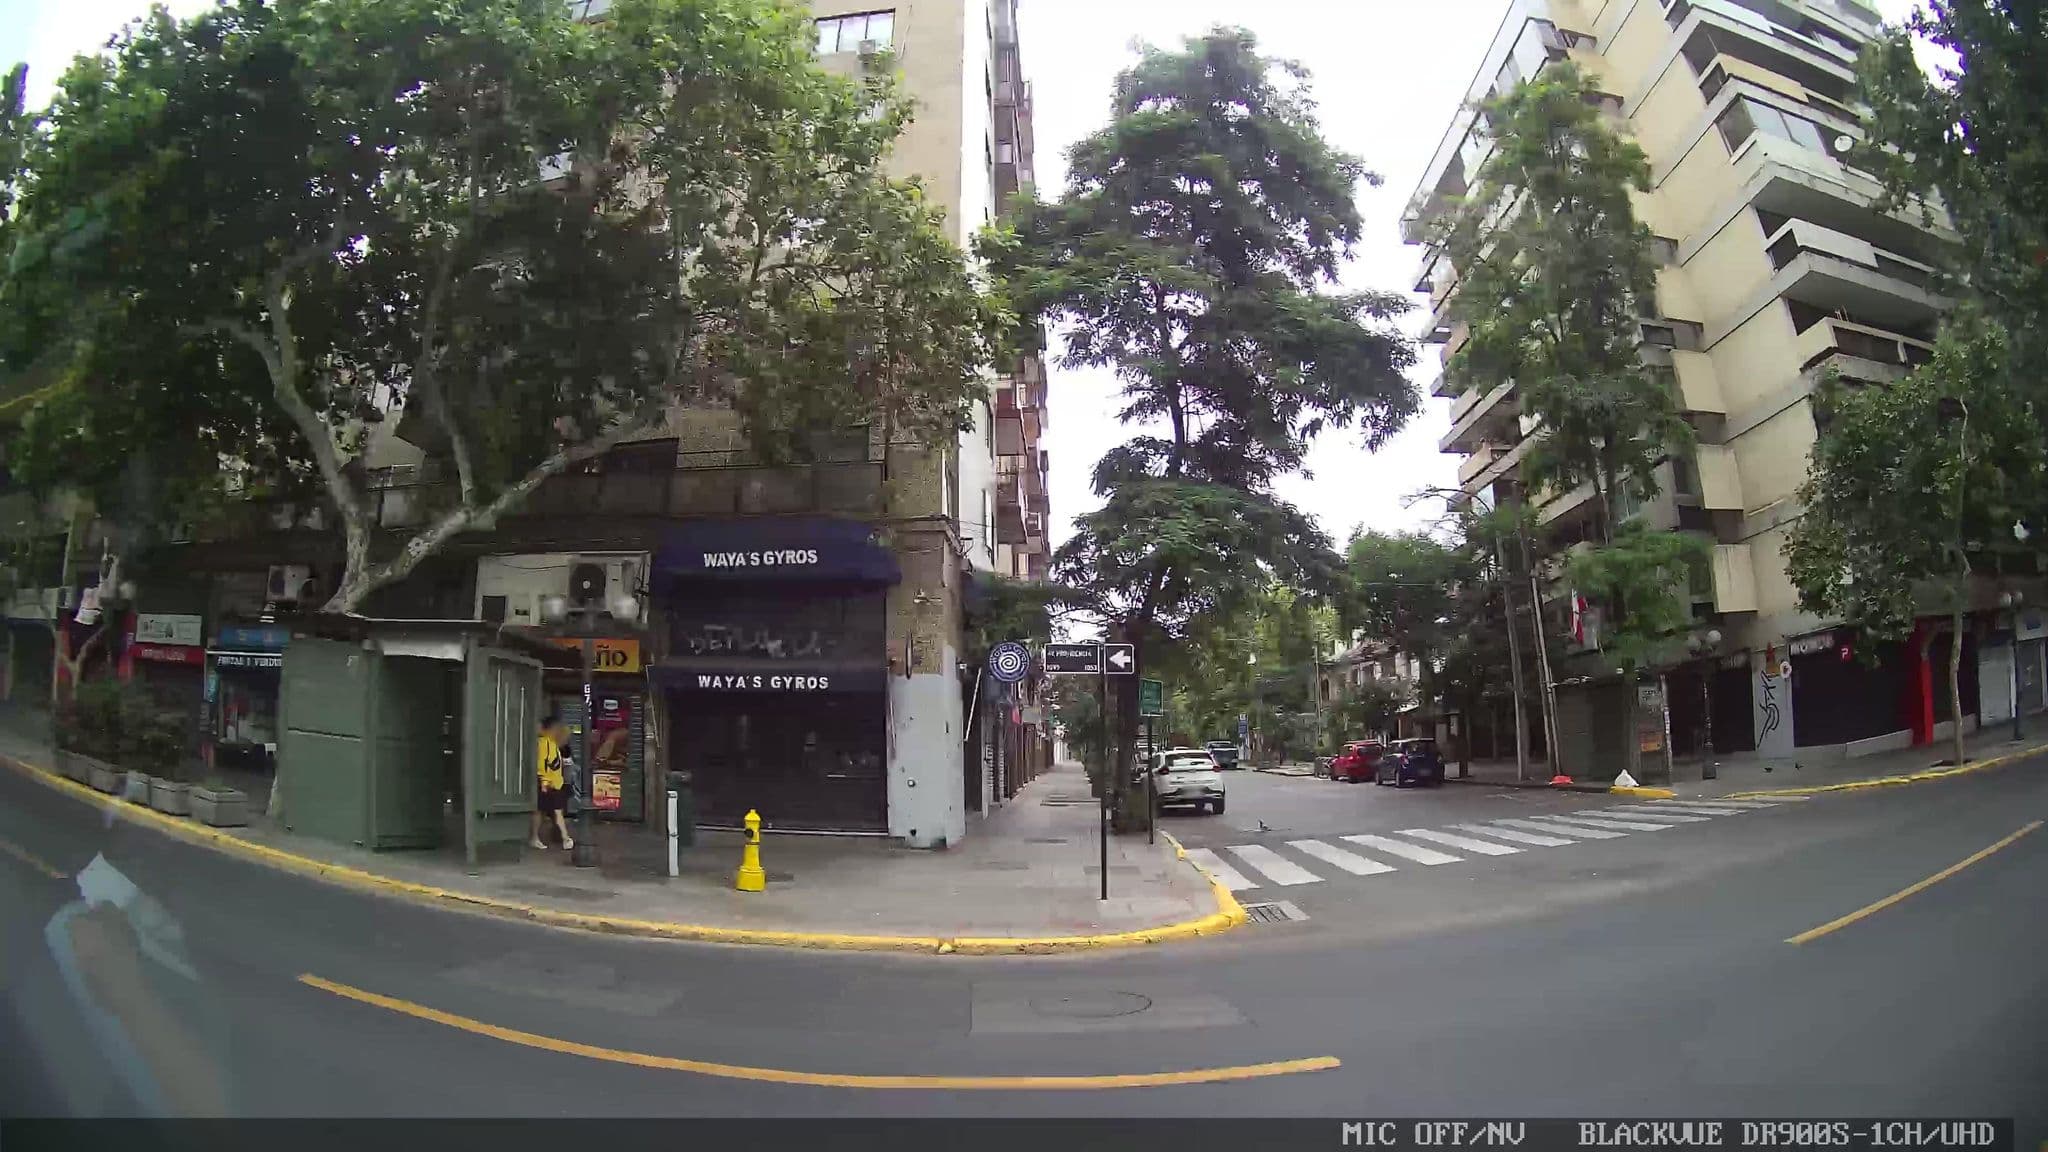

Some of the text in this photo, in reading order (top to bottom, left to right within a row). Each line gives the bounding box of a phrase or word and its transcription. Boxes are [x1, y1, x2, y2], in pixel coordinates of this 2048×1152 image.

[703, 549, 818, 568] WAYA'S GYROS
[698, 674, 829, 690] WAYA'S GYROS
